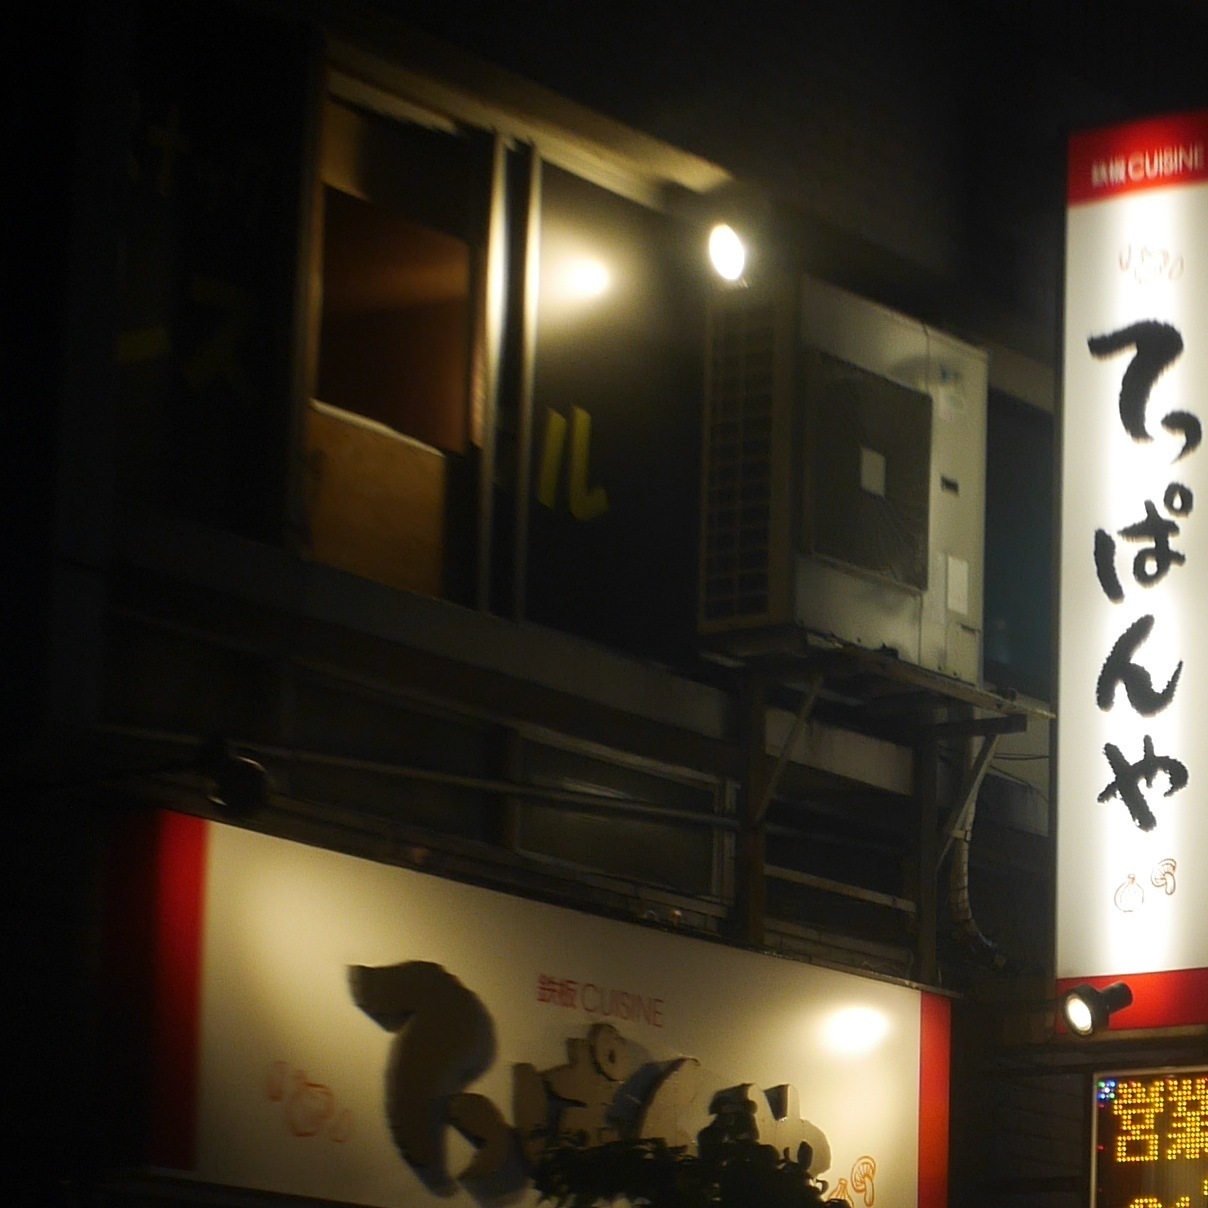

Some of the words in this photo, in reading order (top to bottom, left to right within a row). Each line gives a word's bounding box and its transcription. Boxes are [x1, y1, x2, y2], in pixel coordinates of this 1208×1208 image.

[1088, 318, 1204, 833] てっぱんや
[582, 982, 664, 1028] CUISINE
